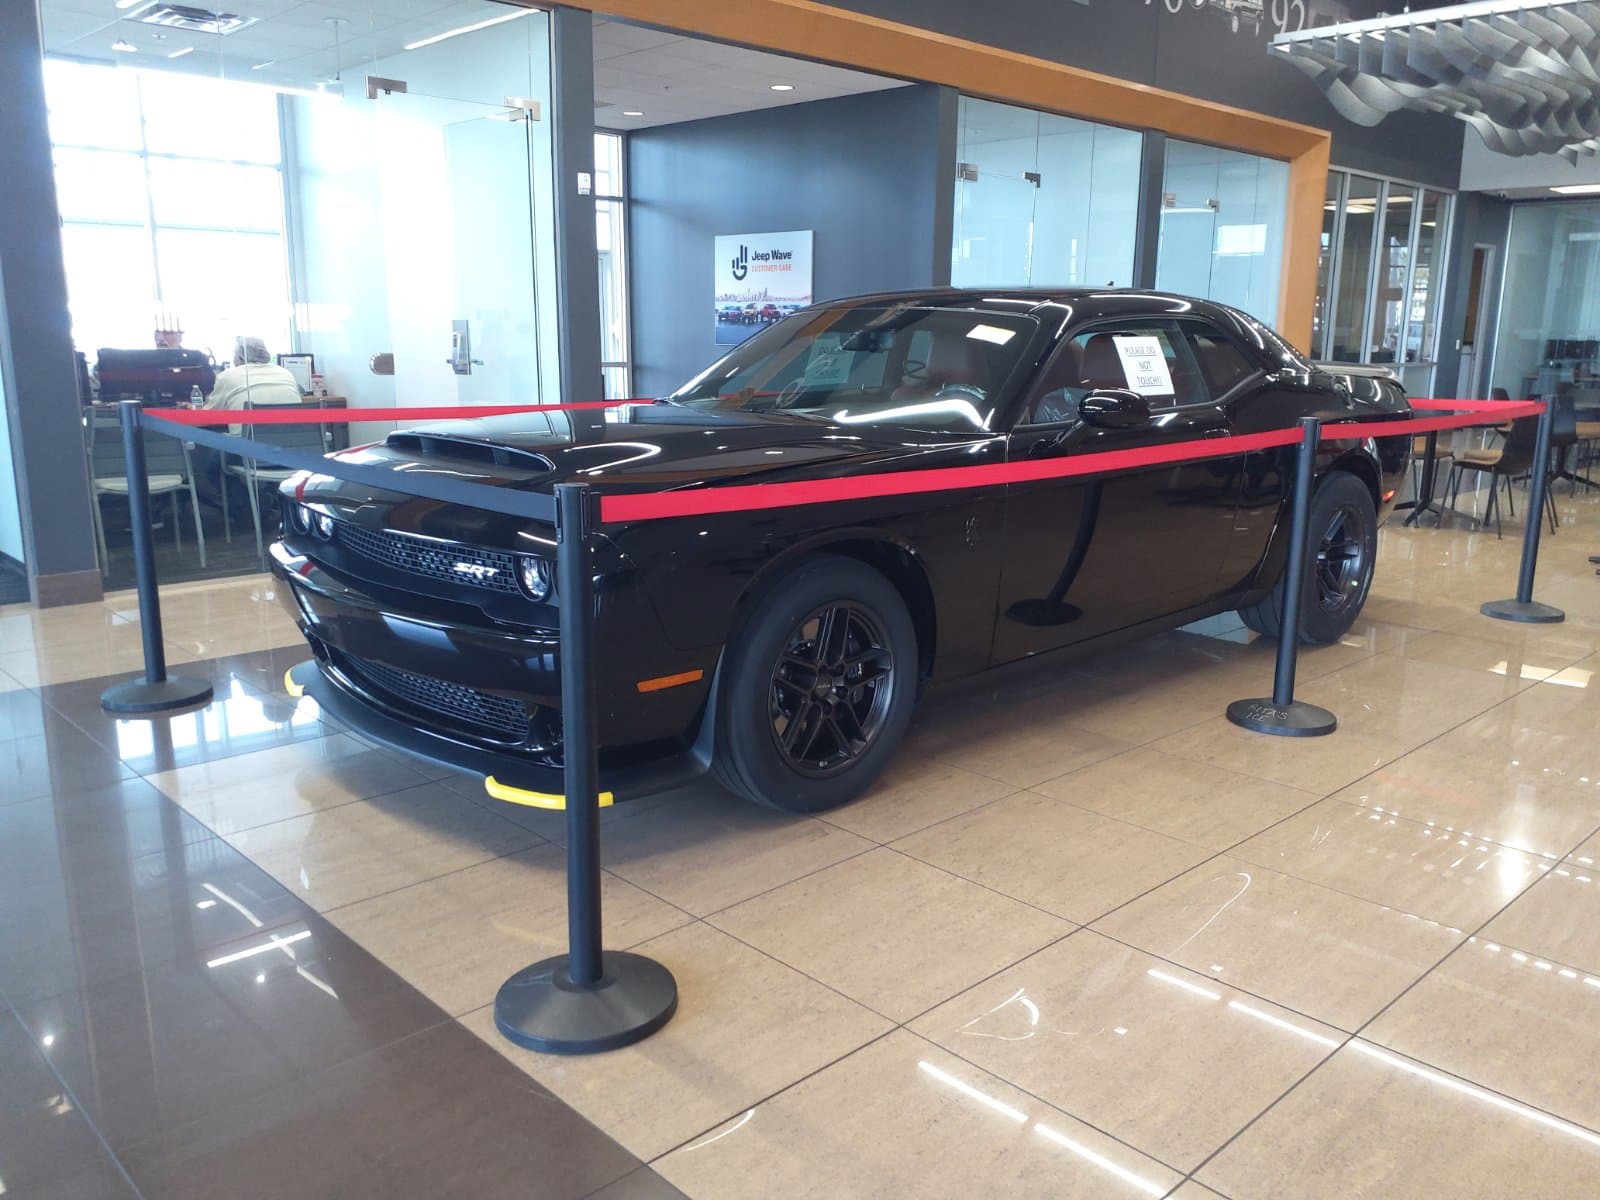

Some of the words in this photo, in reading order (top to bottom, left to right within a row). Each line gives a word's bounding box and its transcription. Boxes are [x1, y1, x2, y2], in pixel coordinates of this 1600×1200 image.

[751, 250, 770, 263] Jeep
[771, 249, 793, 260] Wave
[751, 264, 778, 272] CUSTOMER
[779, 263, 793, 272] CARE
[1124, 346, 1145, 354] PLEASE
[1146, 346, 1155, 354] DO
[1138, 360, 1152, 370] NOT
[453, 562, 500, 579] SRT
